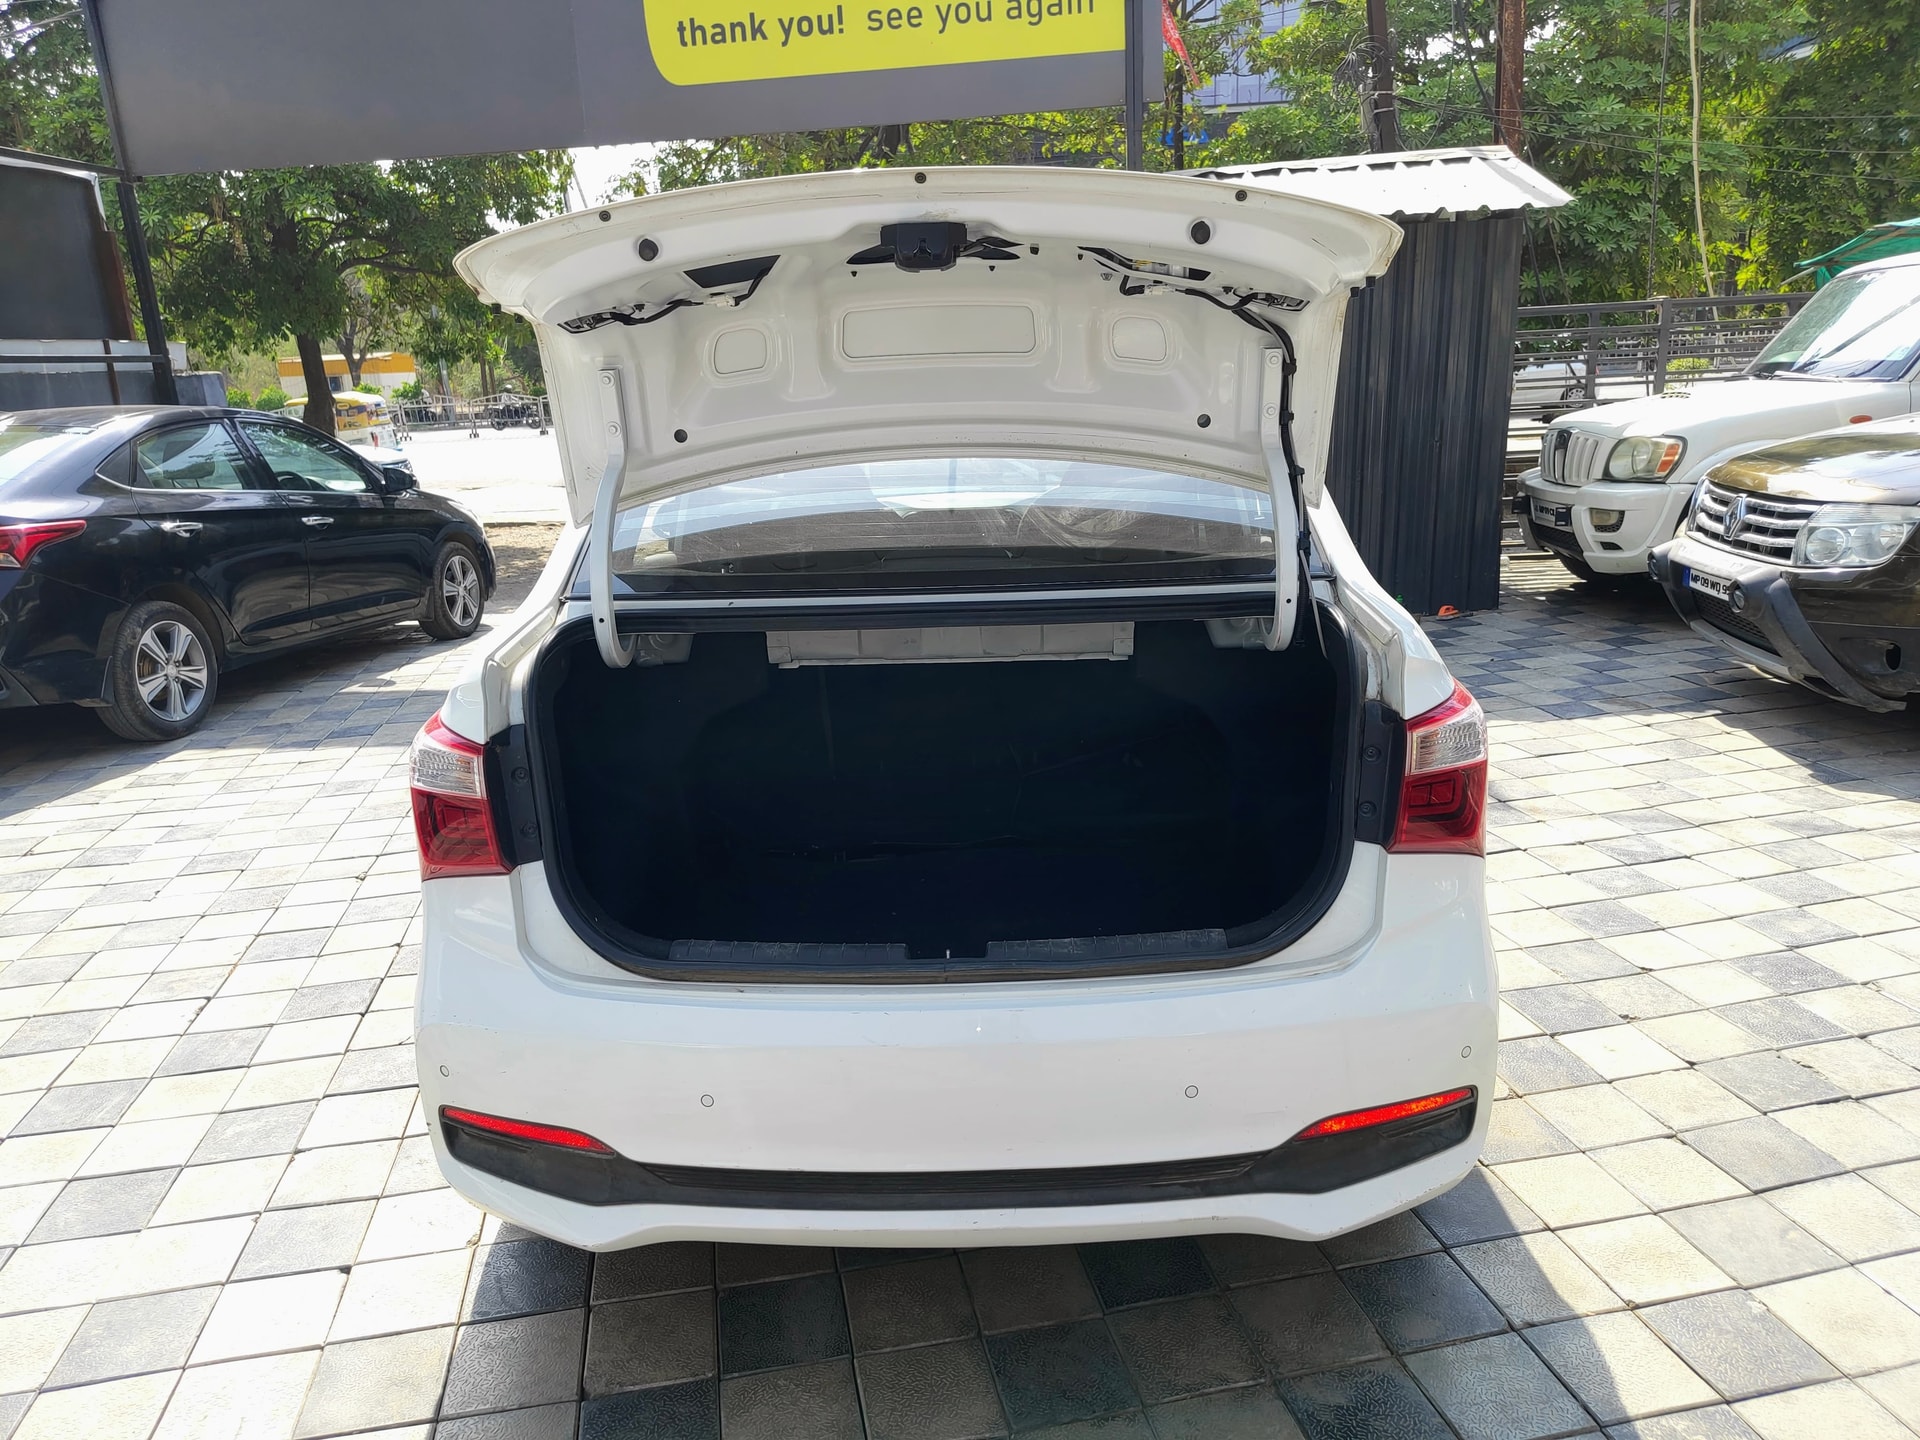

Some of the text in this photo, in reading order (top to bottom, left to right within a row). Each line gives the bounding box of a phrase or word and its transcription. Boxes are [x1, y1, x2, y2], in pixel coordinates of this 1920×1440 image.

[676, 0, 1094, 48] thank you! see you again
[1691, 573, 1700, 584] MP
[1700, 577, 1709, 588] 09
